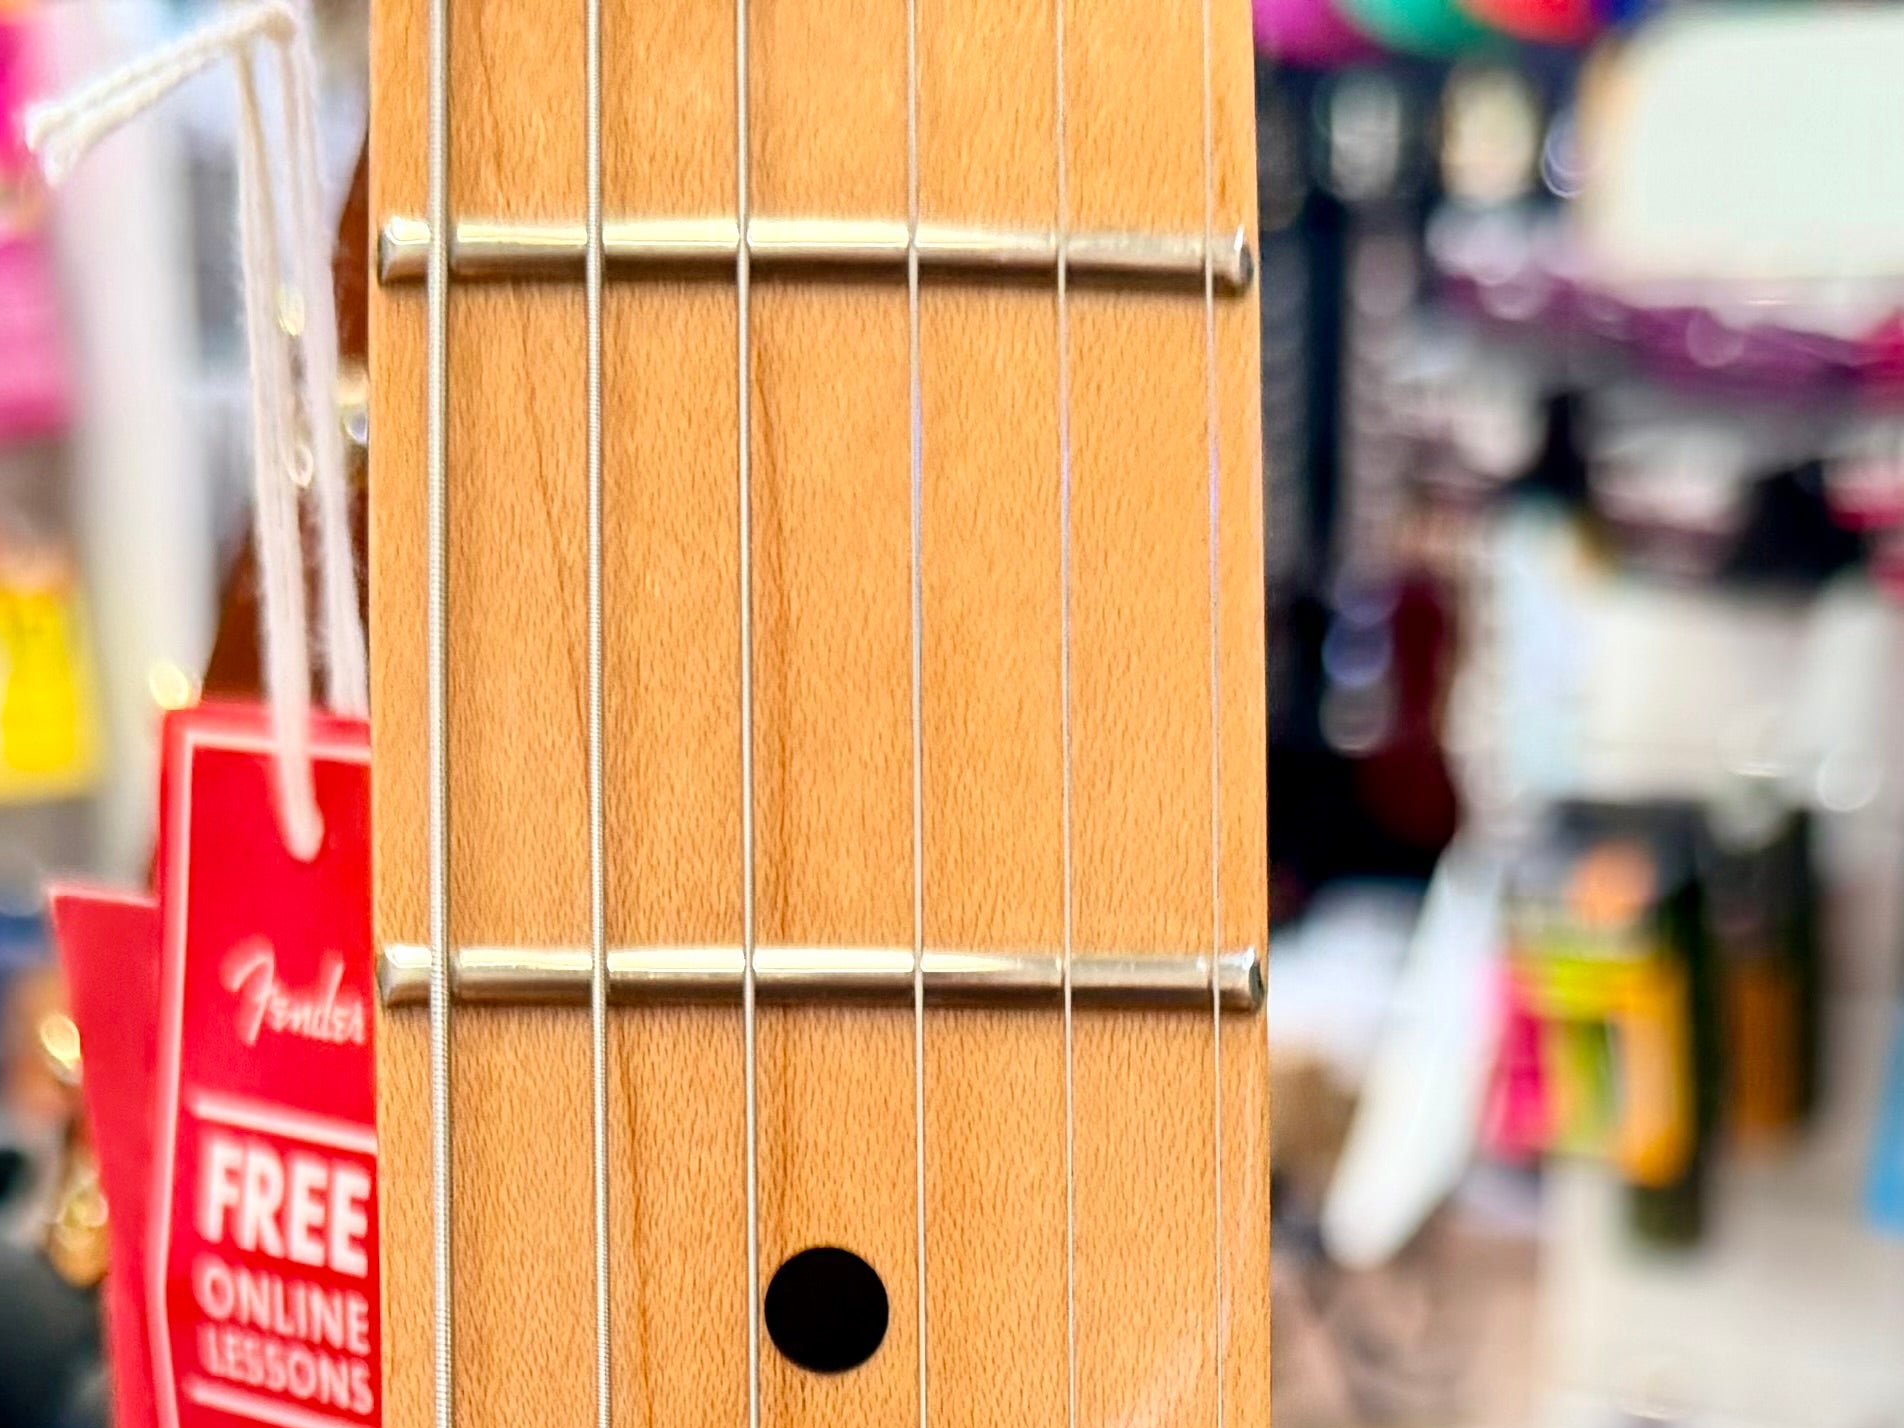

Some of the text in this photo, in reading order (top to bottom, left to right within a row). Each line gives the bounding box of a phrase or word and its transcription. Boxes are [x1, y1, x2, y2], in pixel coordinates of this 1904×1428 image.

[219, 935, 365, 1046] Fender
[198, 1134, 371, 1279] FREE
[193, 1253, 371, 1357] ONLINE
[197, 1320, 374, 1415] LESSONS
